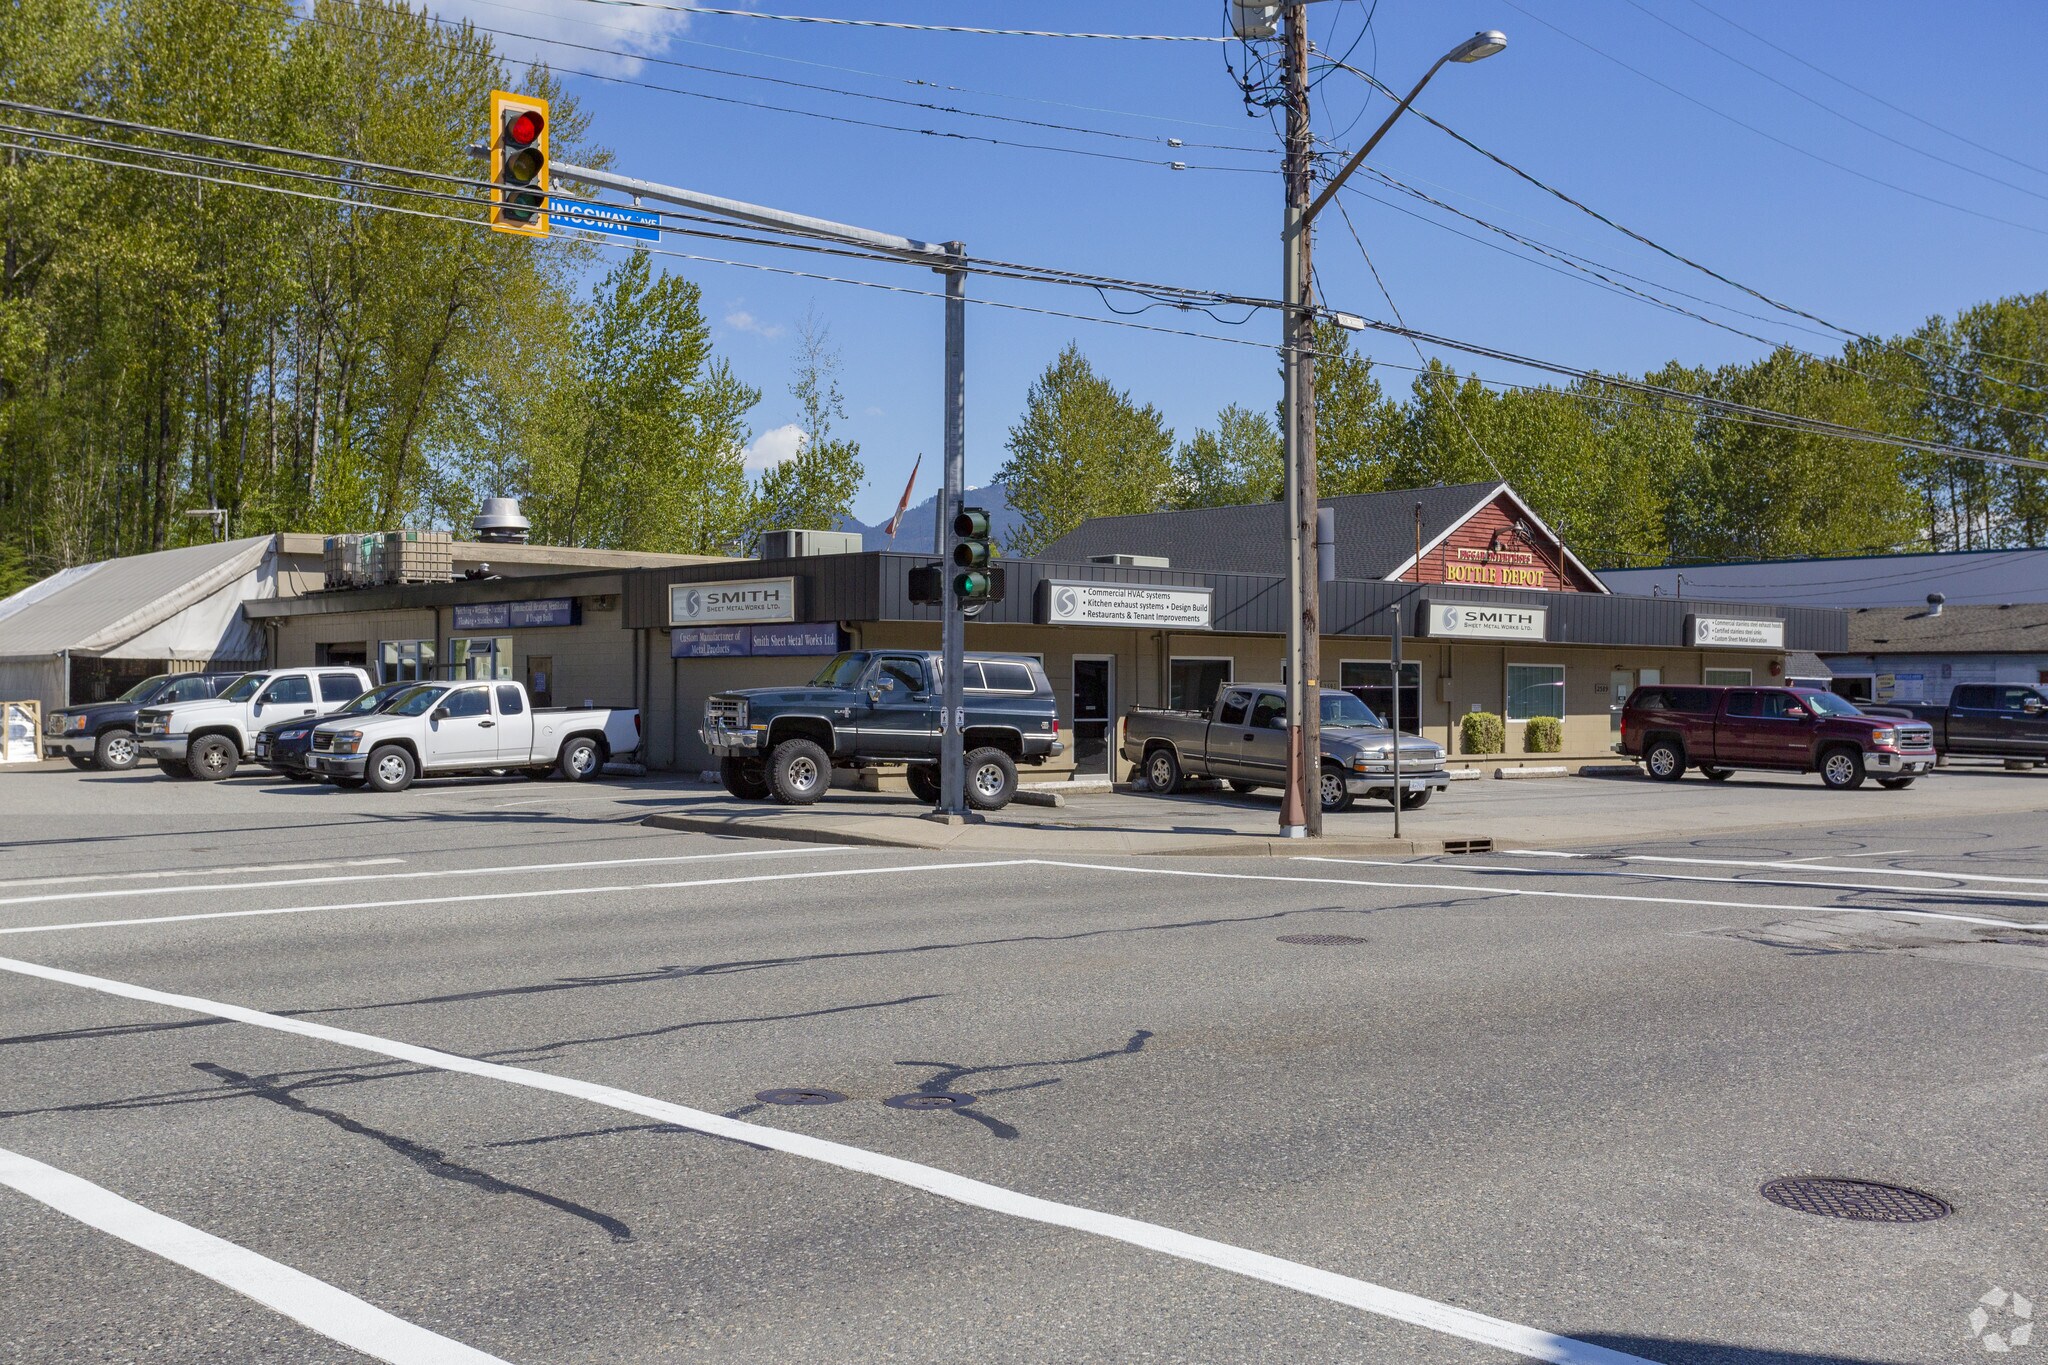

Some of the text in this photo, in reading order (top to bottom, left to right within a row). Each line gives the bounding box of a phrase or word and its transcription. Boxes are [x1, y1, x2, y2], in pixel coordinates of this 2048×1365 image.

[550, 202, 632, 231] INGSWAY
[1446, 564, 1544, 586] BOTTLE DEPOT
[707, 590, 780, 604] SMITH
[1088, 588, 1170, 600] Commercial HVAC systems
[512, 602, 532, 612] Commercial
[1088, 599, 1112, 608] Kitchen
[1114, 600, 1138, 609] exhaust
[1139, 602, 1164, 611] systems
[1170, 604, 1191, 612] Design
[1088, 610, 1126, 620] Restaurants
[1156, 613, 1200, 622] Improvements
[1464, 611, 1532, 624] SMITH
[680, 630, 741, 642] Custom Manufacturer of
[753, 634, 836, 647] Smith Sheet Metal Works Ltd.
[691, 644, 730, 654] Metal Products
